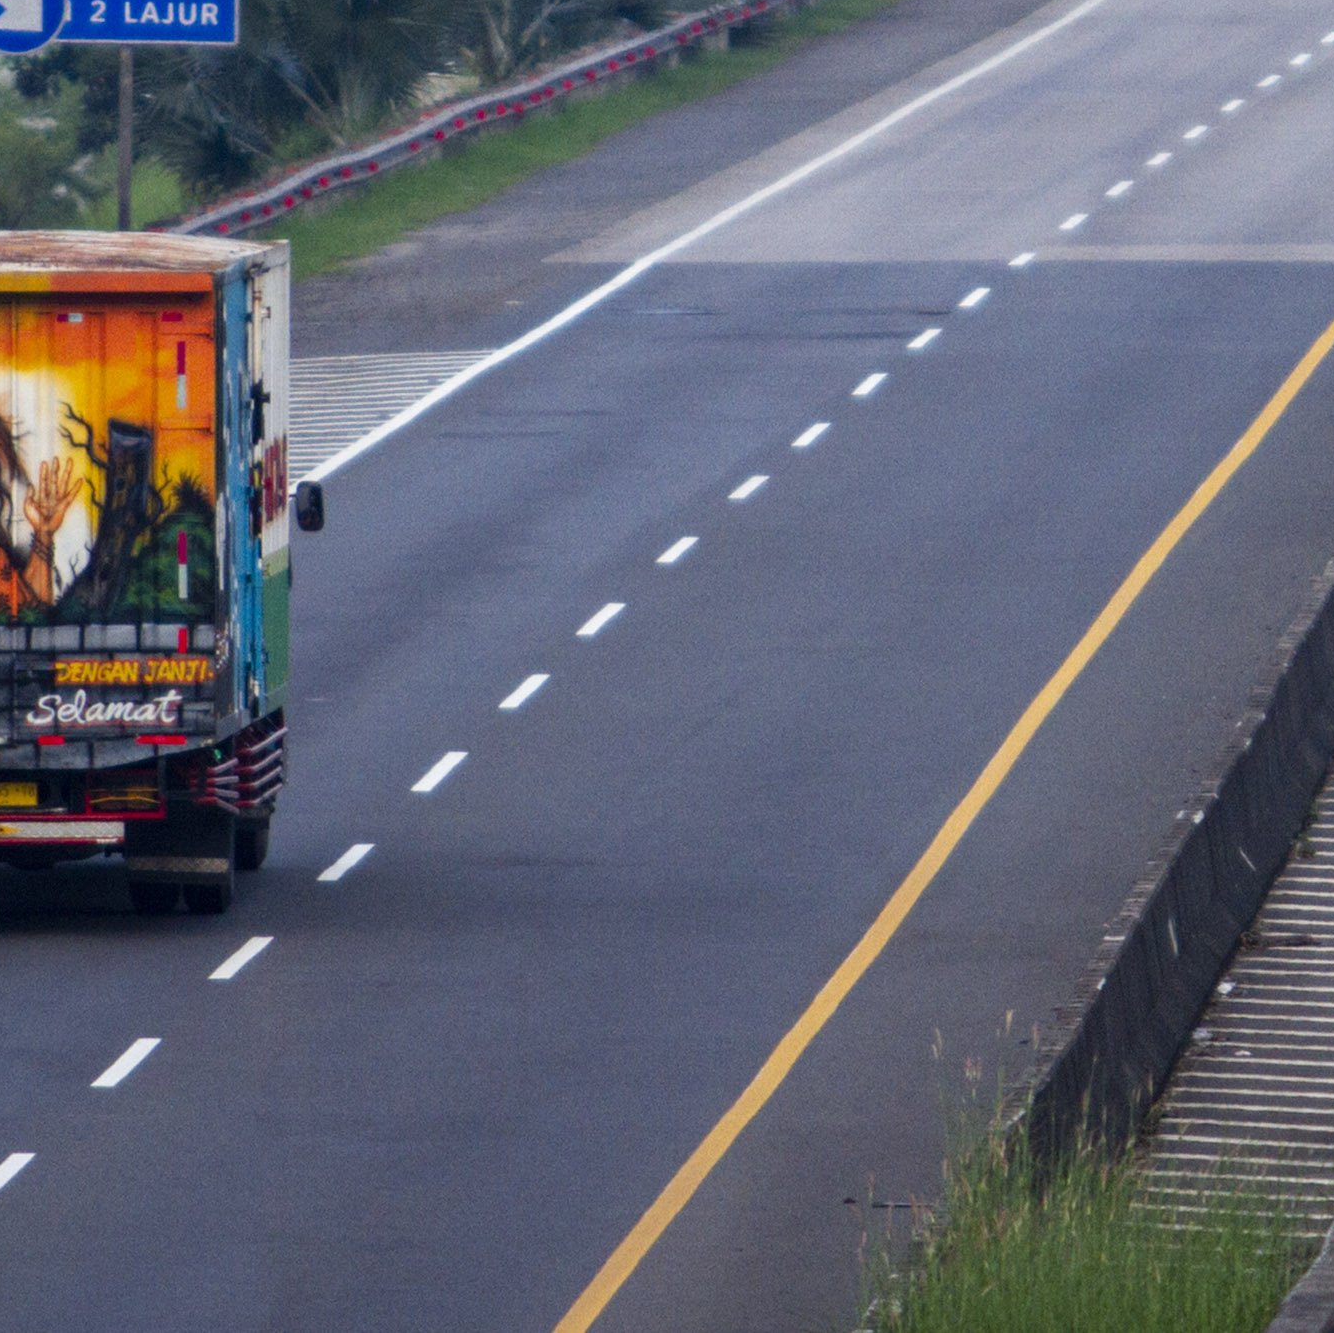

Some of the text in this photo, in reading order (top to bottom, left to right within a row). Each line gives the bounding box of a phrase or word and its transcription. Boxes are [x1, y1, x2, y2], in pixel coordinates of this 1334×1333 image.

[90, 0, 106, 24] 2
[124, 2, 219, 26] LAJUR
[54, 661, 140, 683] DENGAN
[26, 688, 183, 725] Selamat
